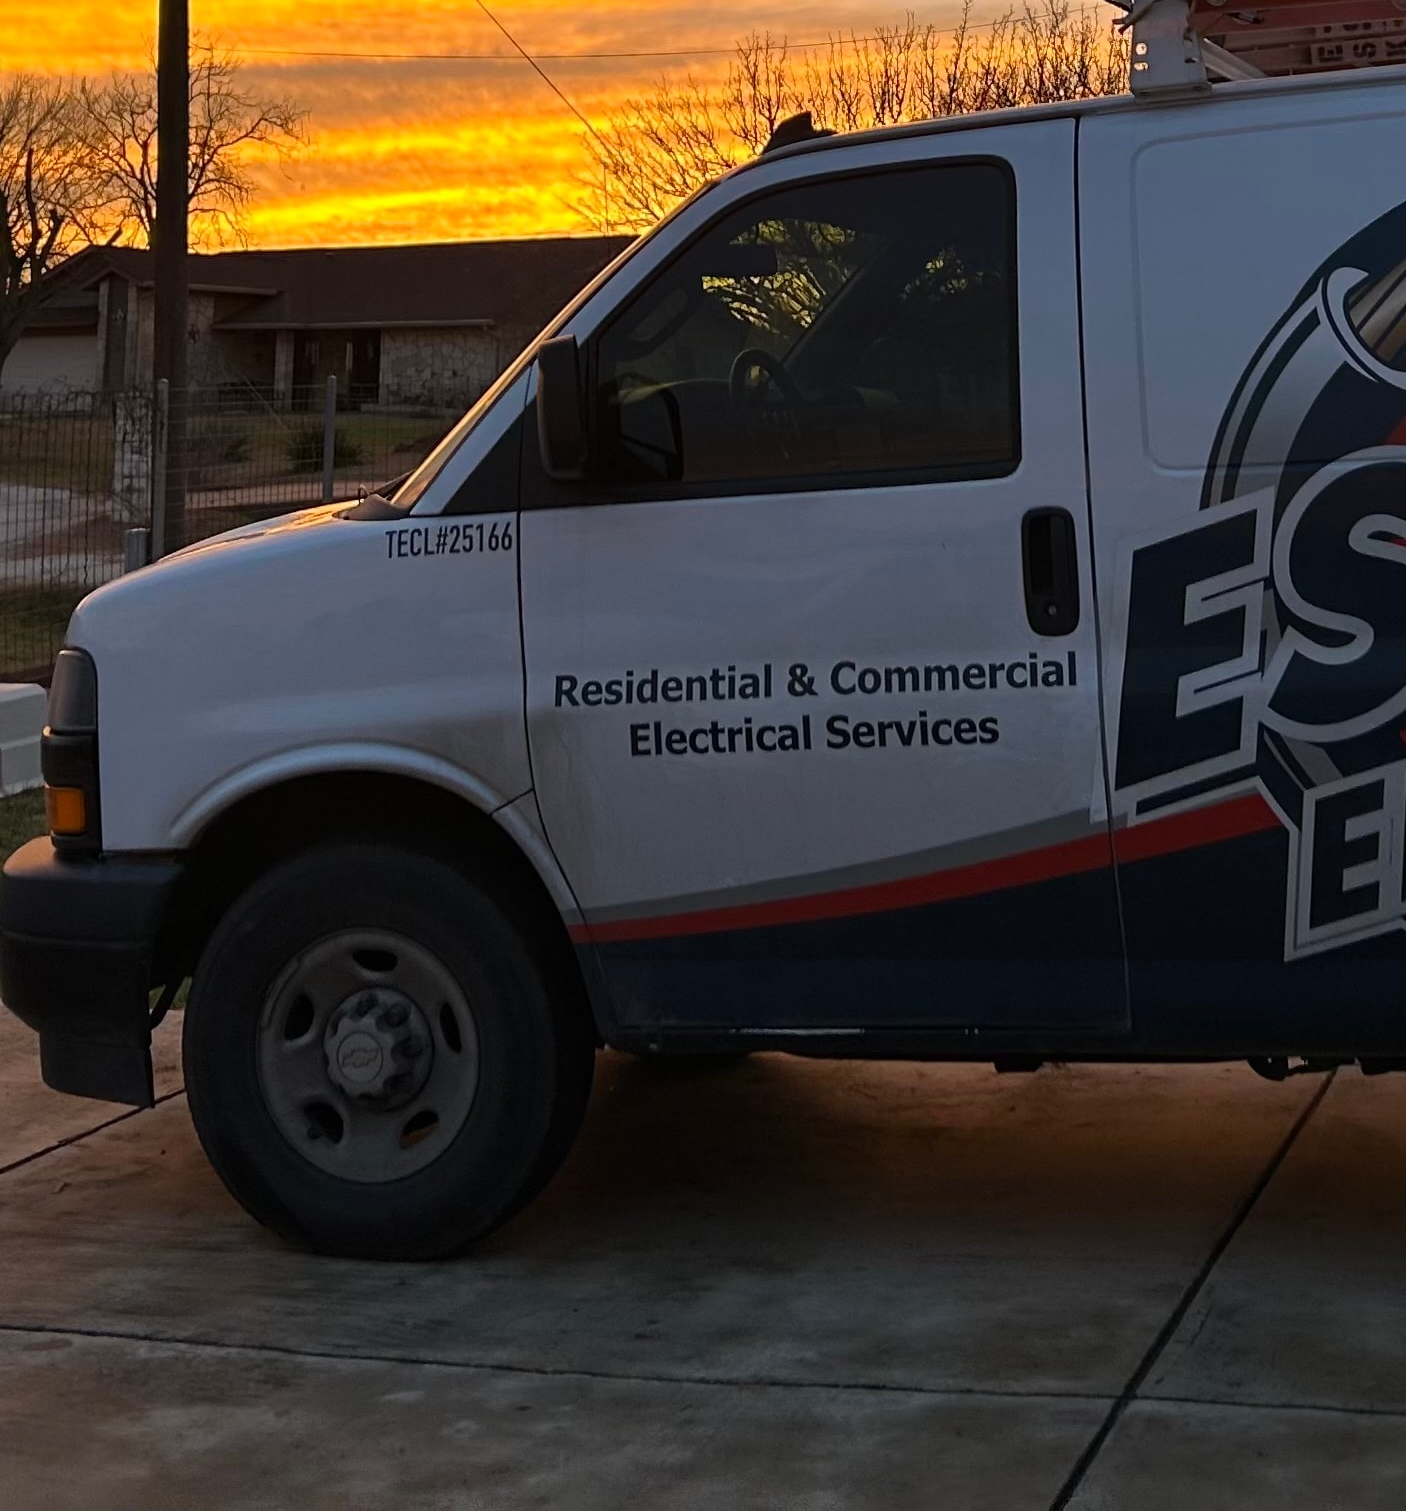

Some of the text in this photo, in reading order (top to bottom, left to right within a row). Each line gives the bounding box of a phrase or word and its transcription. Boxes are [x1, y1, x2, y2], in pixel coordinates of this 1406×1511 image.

[386, 520, 513, 559] TECL#25166
[554, 650, 1077, 708] Residential & Commercial
[629, 710, 1000, 757] Electrical Services
